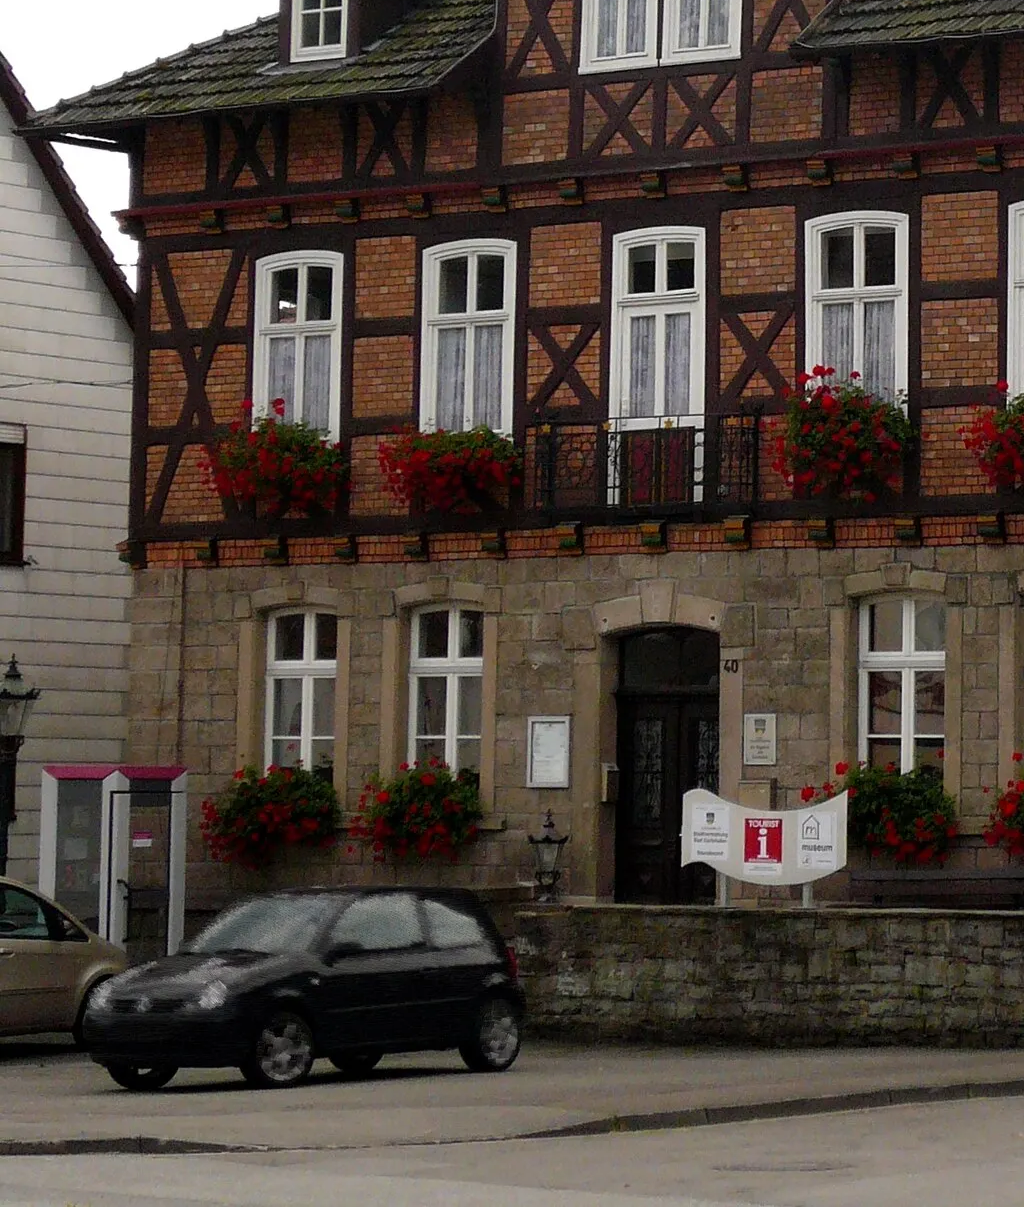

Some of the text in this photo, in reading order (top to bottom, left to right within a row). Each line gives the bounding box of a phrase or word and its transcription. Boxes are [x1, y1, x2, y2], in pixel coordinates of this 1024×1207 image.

[723, 659, 739, 674] 40
[748, 819, 779, 828] TOURIST
[757, 828, 770, 859] i
[801, 844, 833, 852] museum
